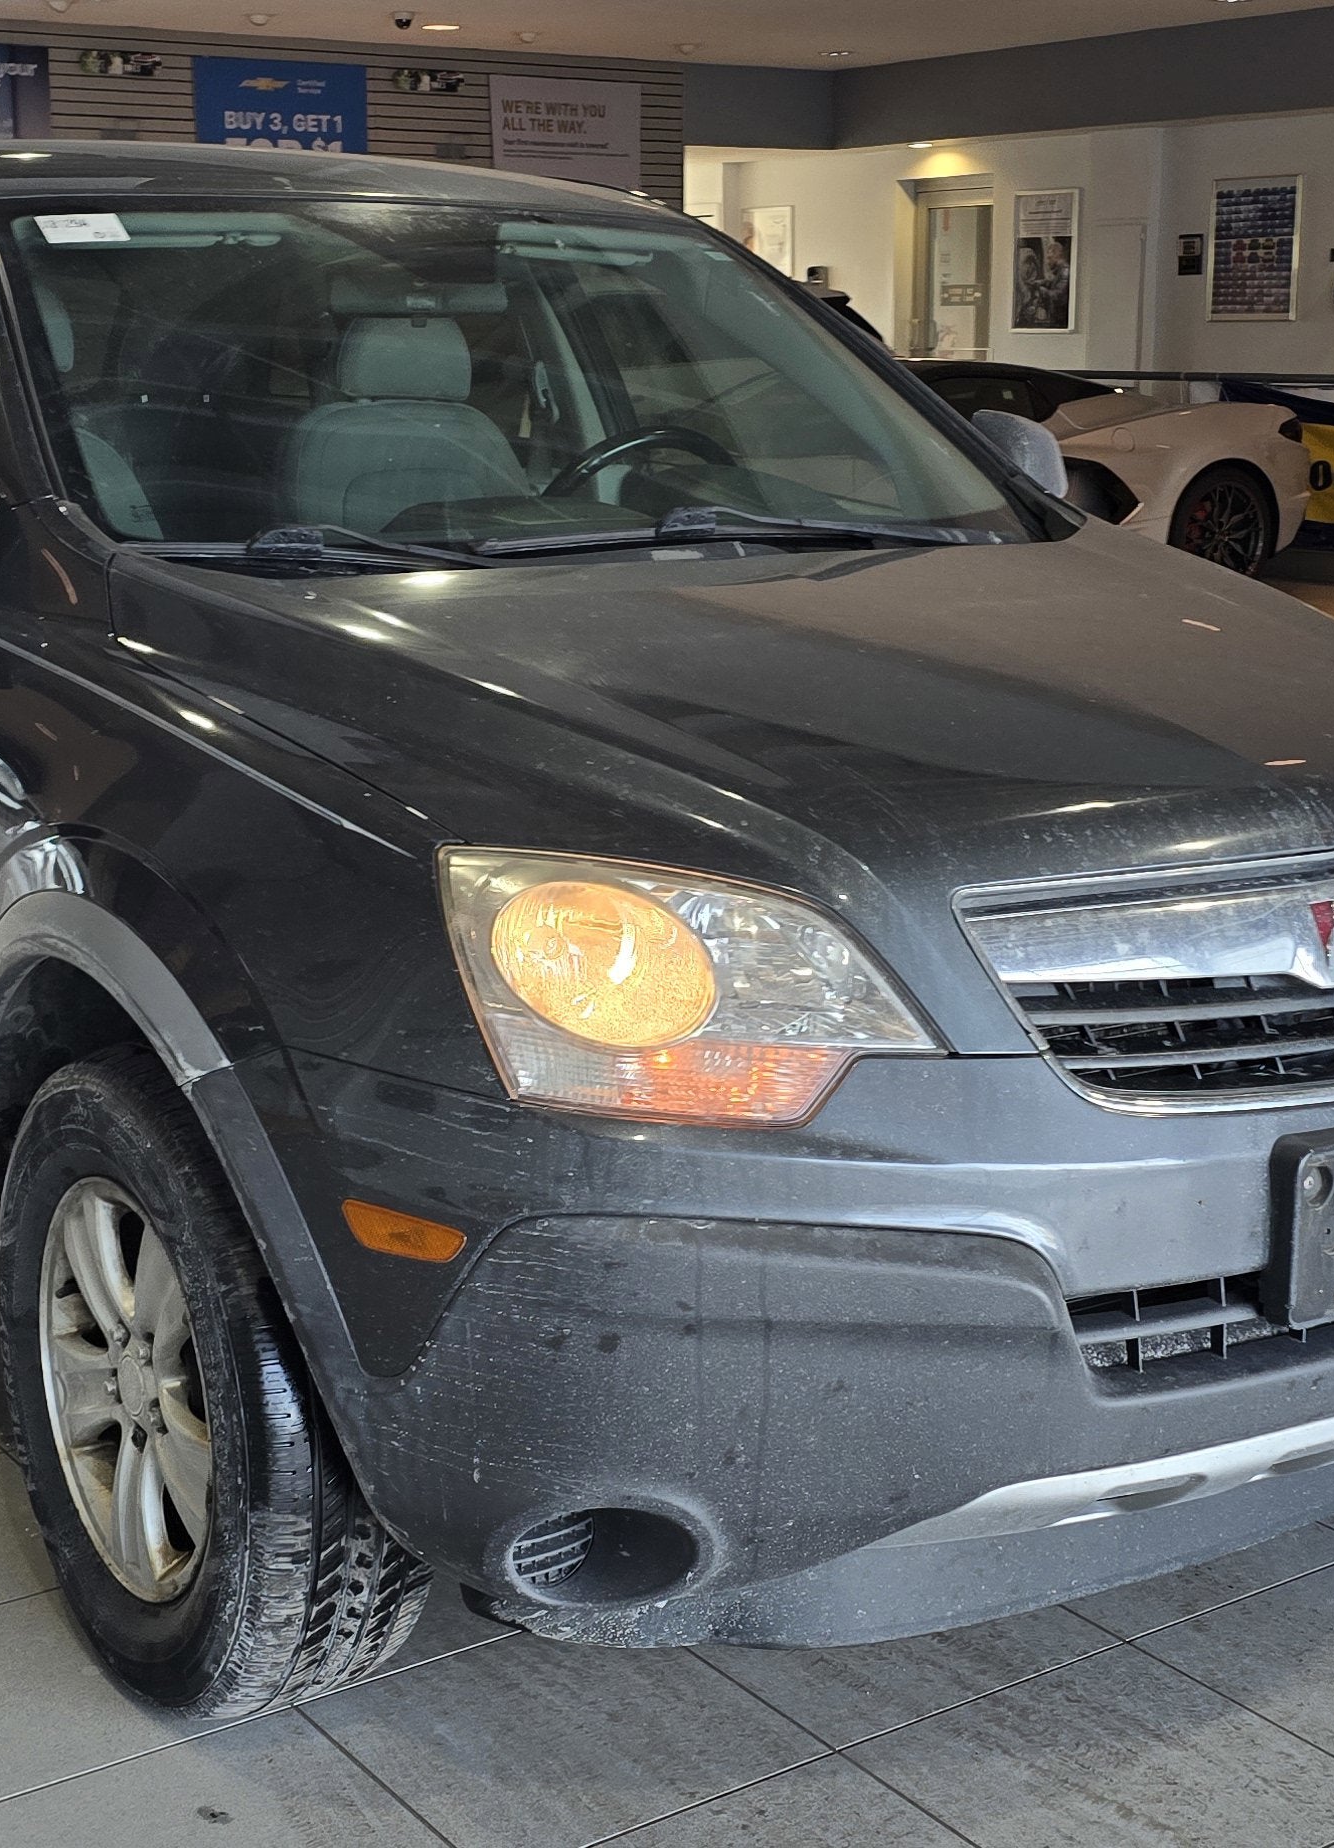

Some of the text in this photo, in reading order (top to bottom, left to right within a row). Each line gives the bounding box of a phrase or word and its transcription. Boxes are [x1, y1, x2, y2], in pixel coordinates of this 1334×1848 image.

[545, 102, 579, 117] WITH
[582, 103, 607, 118] YOU
[223, 111, 343, 135] BUY 3, GET 1
[502, 117, 588, 134] ALL THE WAY.
